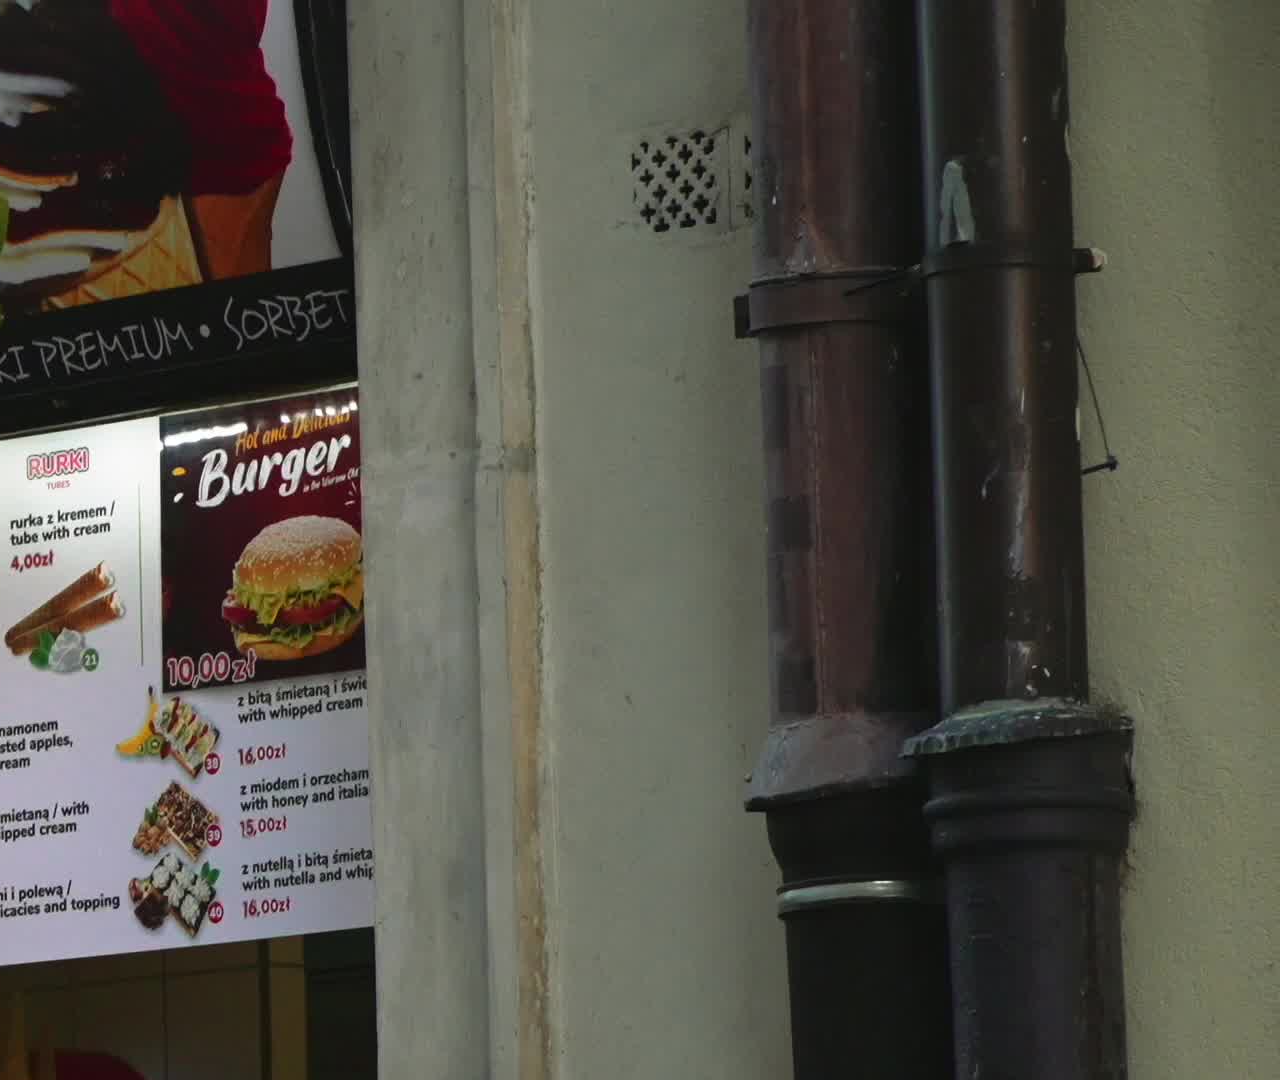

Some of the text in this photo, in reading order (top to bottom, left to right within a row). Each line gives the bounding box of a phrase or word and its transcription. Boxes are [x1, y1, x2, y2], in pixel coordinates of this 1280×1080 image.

[31, 316, 194, 379] PREMIUM
[224, 289, 349, 351] SORBET
[26, 447, 90, 481] RURKI
[196, 433, 352, 508] Burger
[48, 480, 70, 489] TUBES
[11, 507, 106, 530] rurka kremem
[10, 523, 110, 546] tube with cream
[11, 550, 53, 573] 4,00zł
[276, 680, 330, 701] śmietaną
[269, 697, 363, 719] whipped cream
[251, 777, 299, 794] miodem
[272, 791, 308, 808] honey
[253, 856, 294, 873] nutellą
[274, 867, 315, 888] nutella
[19, 879, 63, 902] polewą
[71, 889, 120, 912] topping
